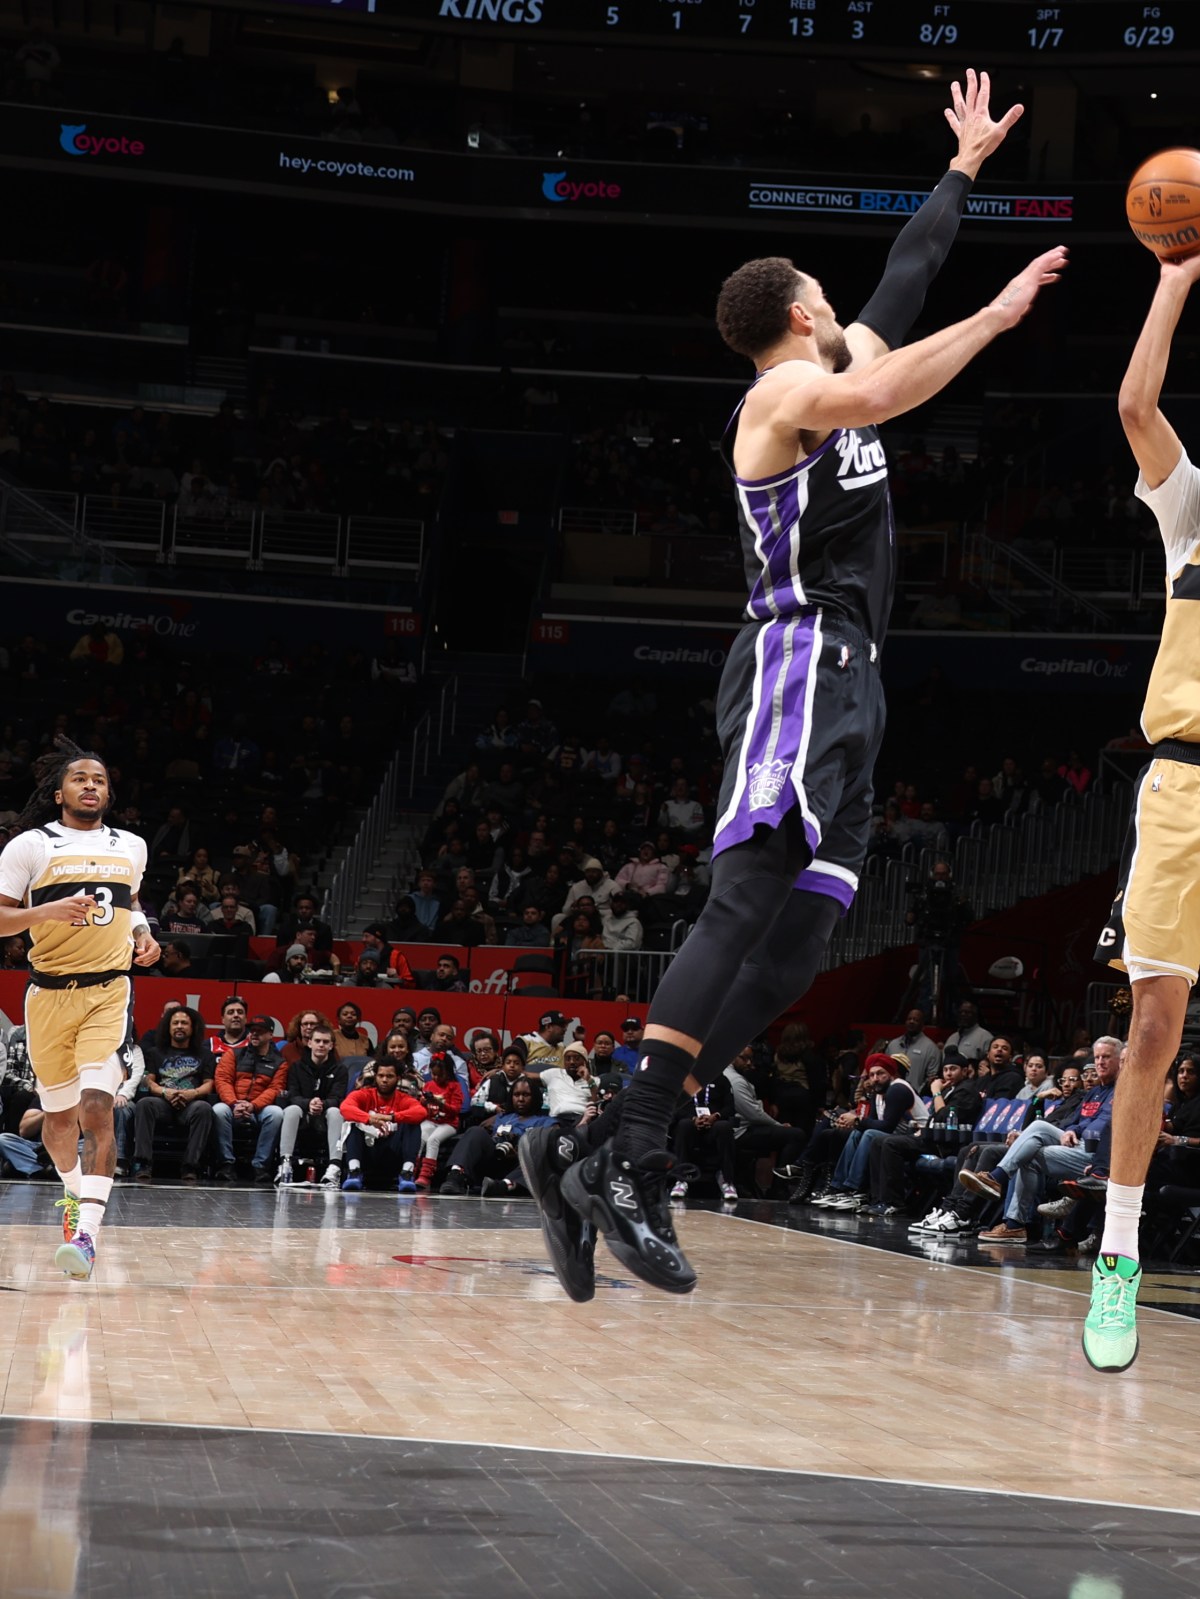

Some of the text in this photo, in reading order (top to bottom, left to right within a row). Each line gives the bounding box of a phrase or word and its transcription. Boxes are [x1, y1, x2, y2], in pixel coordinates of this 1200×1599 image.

[439, 0, 543, 23] KINGS
[790, 0, 816, 10] REB
[848, 2, 873, 13] AST
[934, 5, 950, 16] FT
[1036, 9, 1060, 20] 3PT
[1143, 7, 1160, 18] FG
[606, 7, 864, 38] 5 1 7 13 3
[919, 24, 957, 45] 8/9
[1028, 28, 1063, 49] 1/7
[1124, 26, 1174, 47] 6/29
[279, 152, 414, 181] hey-coyote.com
[749, 189, 1073, 218] CONNECTING BRAN WITH FANS
[391, 618, 415, 632] 116
[538, 625, 563, 639] 115
[633, 645, 727, 668] CapitalO
[52, 861, 130, 879] washington
